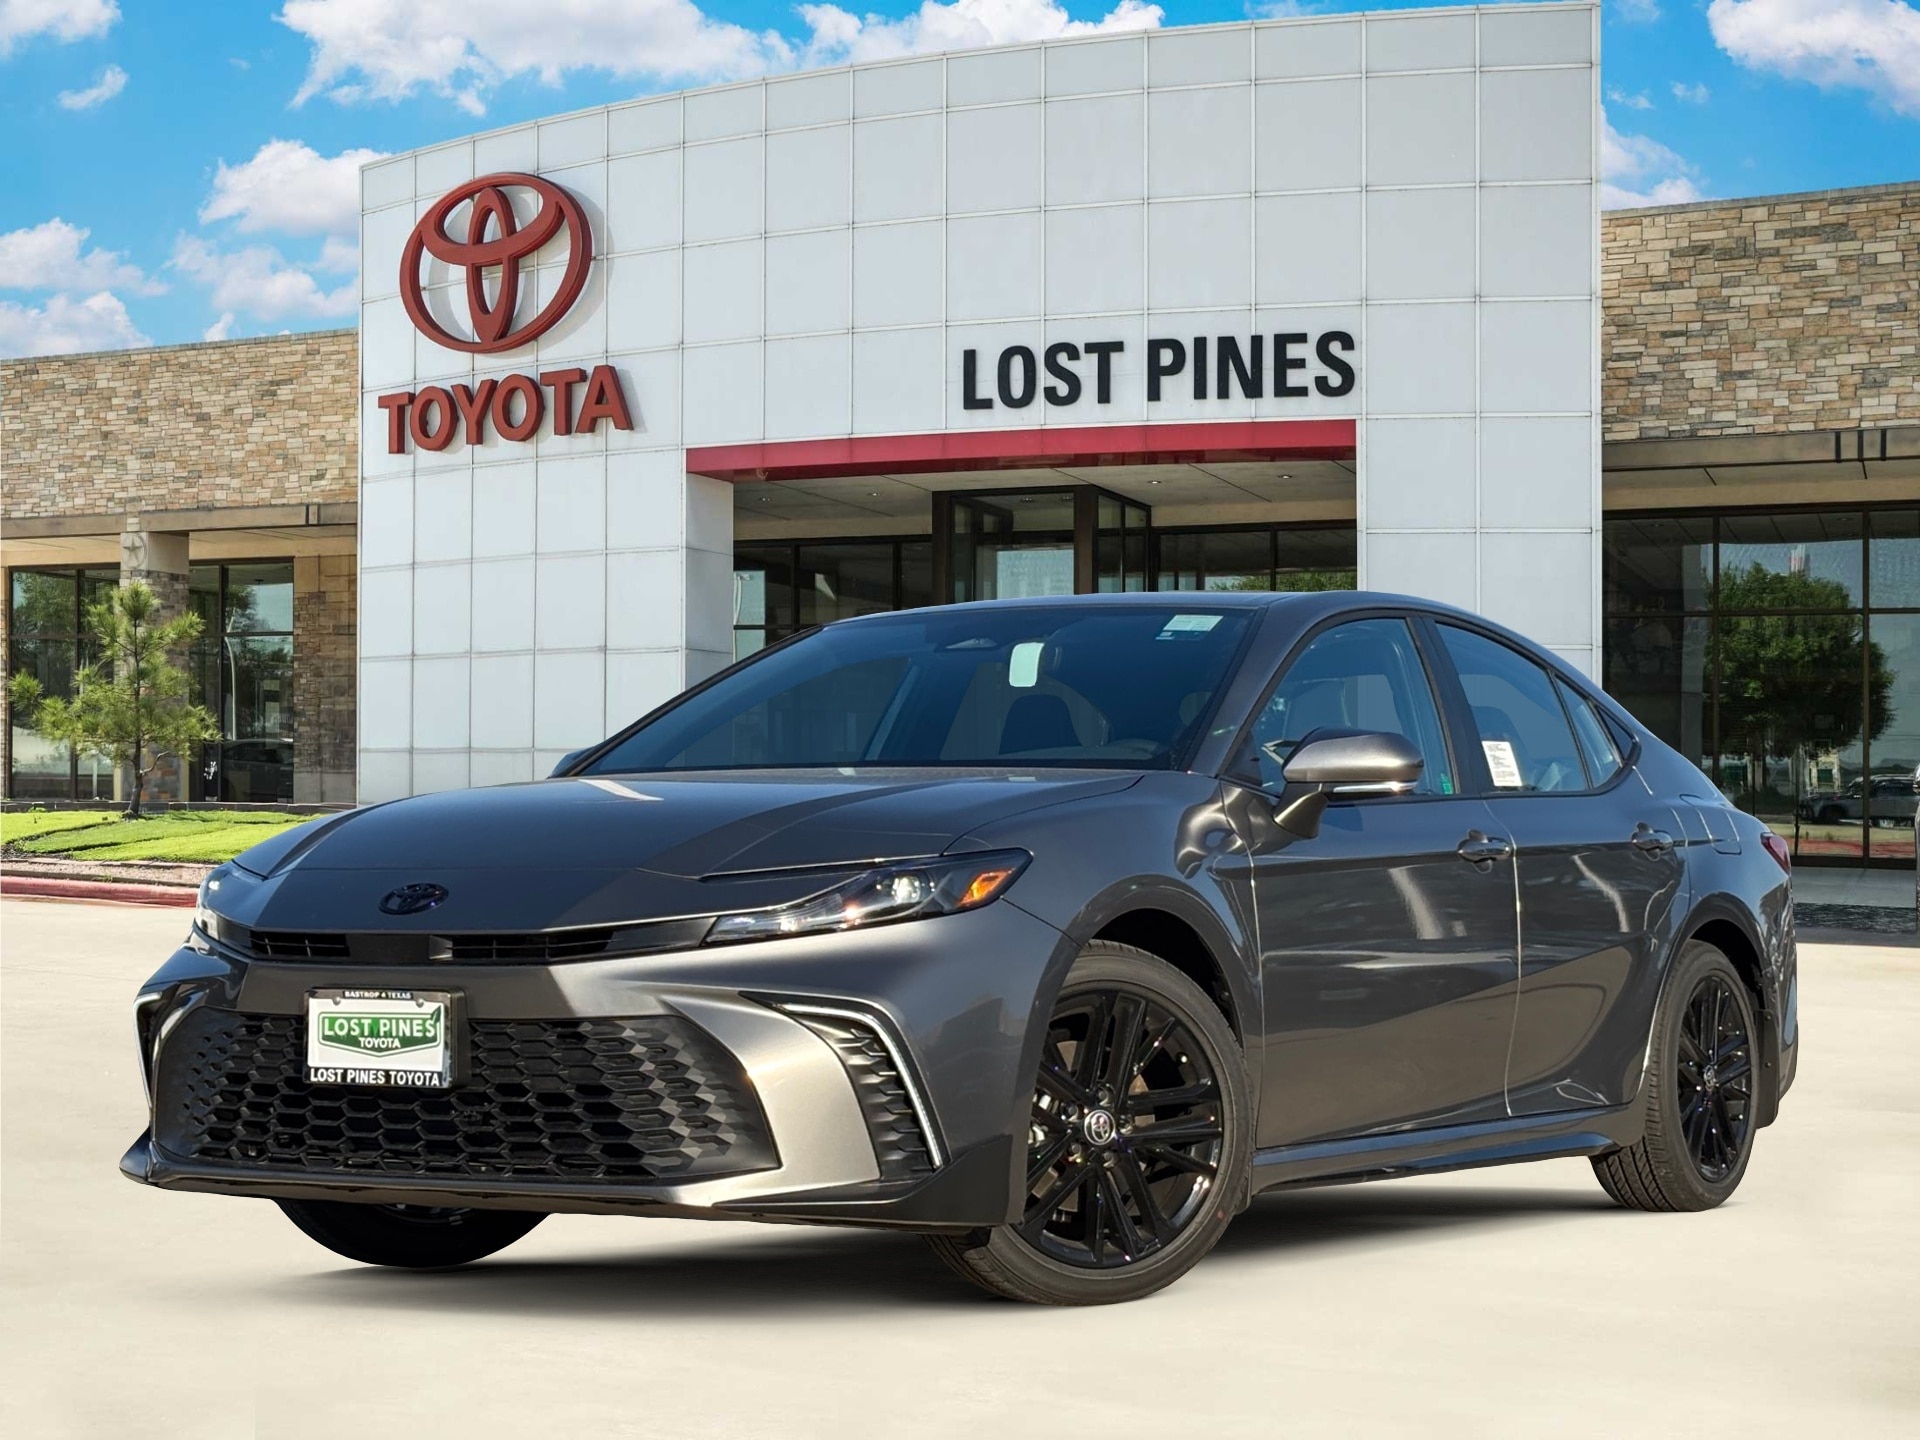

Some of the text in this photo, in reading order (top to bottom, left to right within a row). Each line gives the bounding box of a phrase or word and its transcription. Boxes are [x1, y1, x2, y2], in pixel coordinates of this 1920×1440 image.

[962, 330, 1355, 410] LOST PINES
[378, 365, 634, 454] TOYOTA
[387, 991, 411, 999] TEXAS
[324, 1018, 435, 1037] LOST PINES
[358, 1037, 400, 1048] TOYOTA
[310, 1068, 440, 1086] LOST PINES TOYOTA
